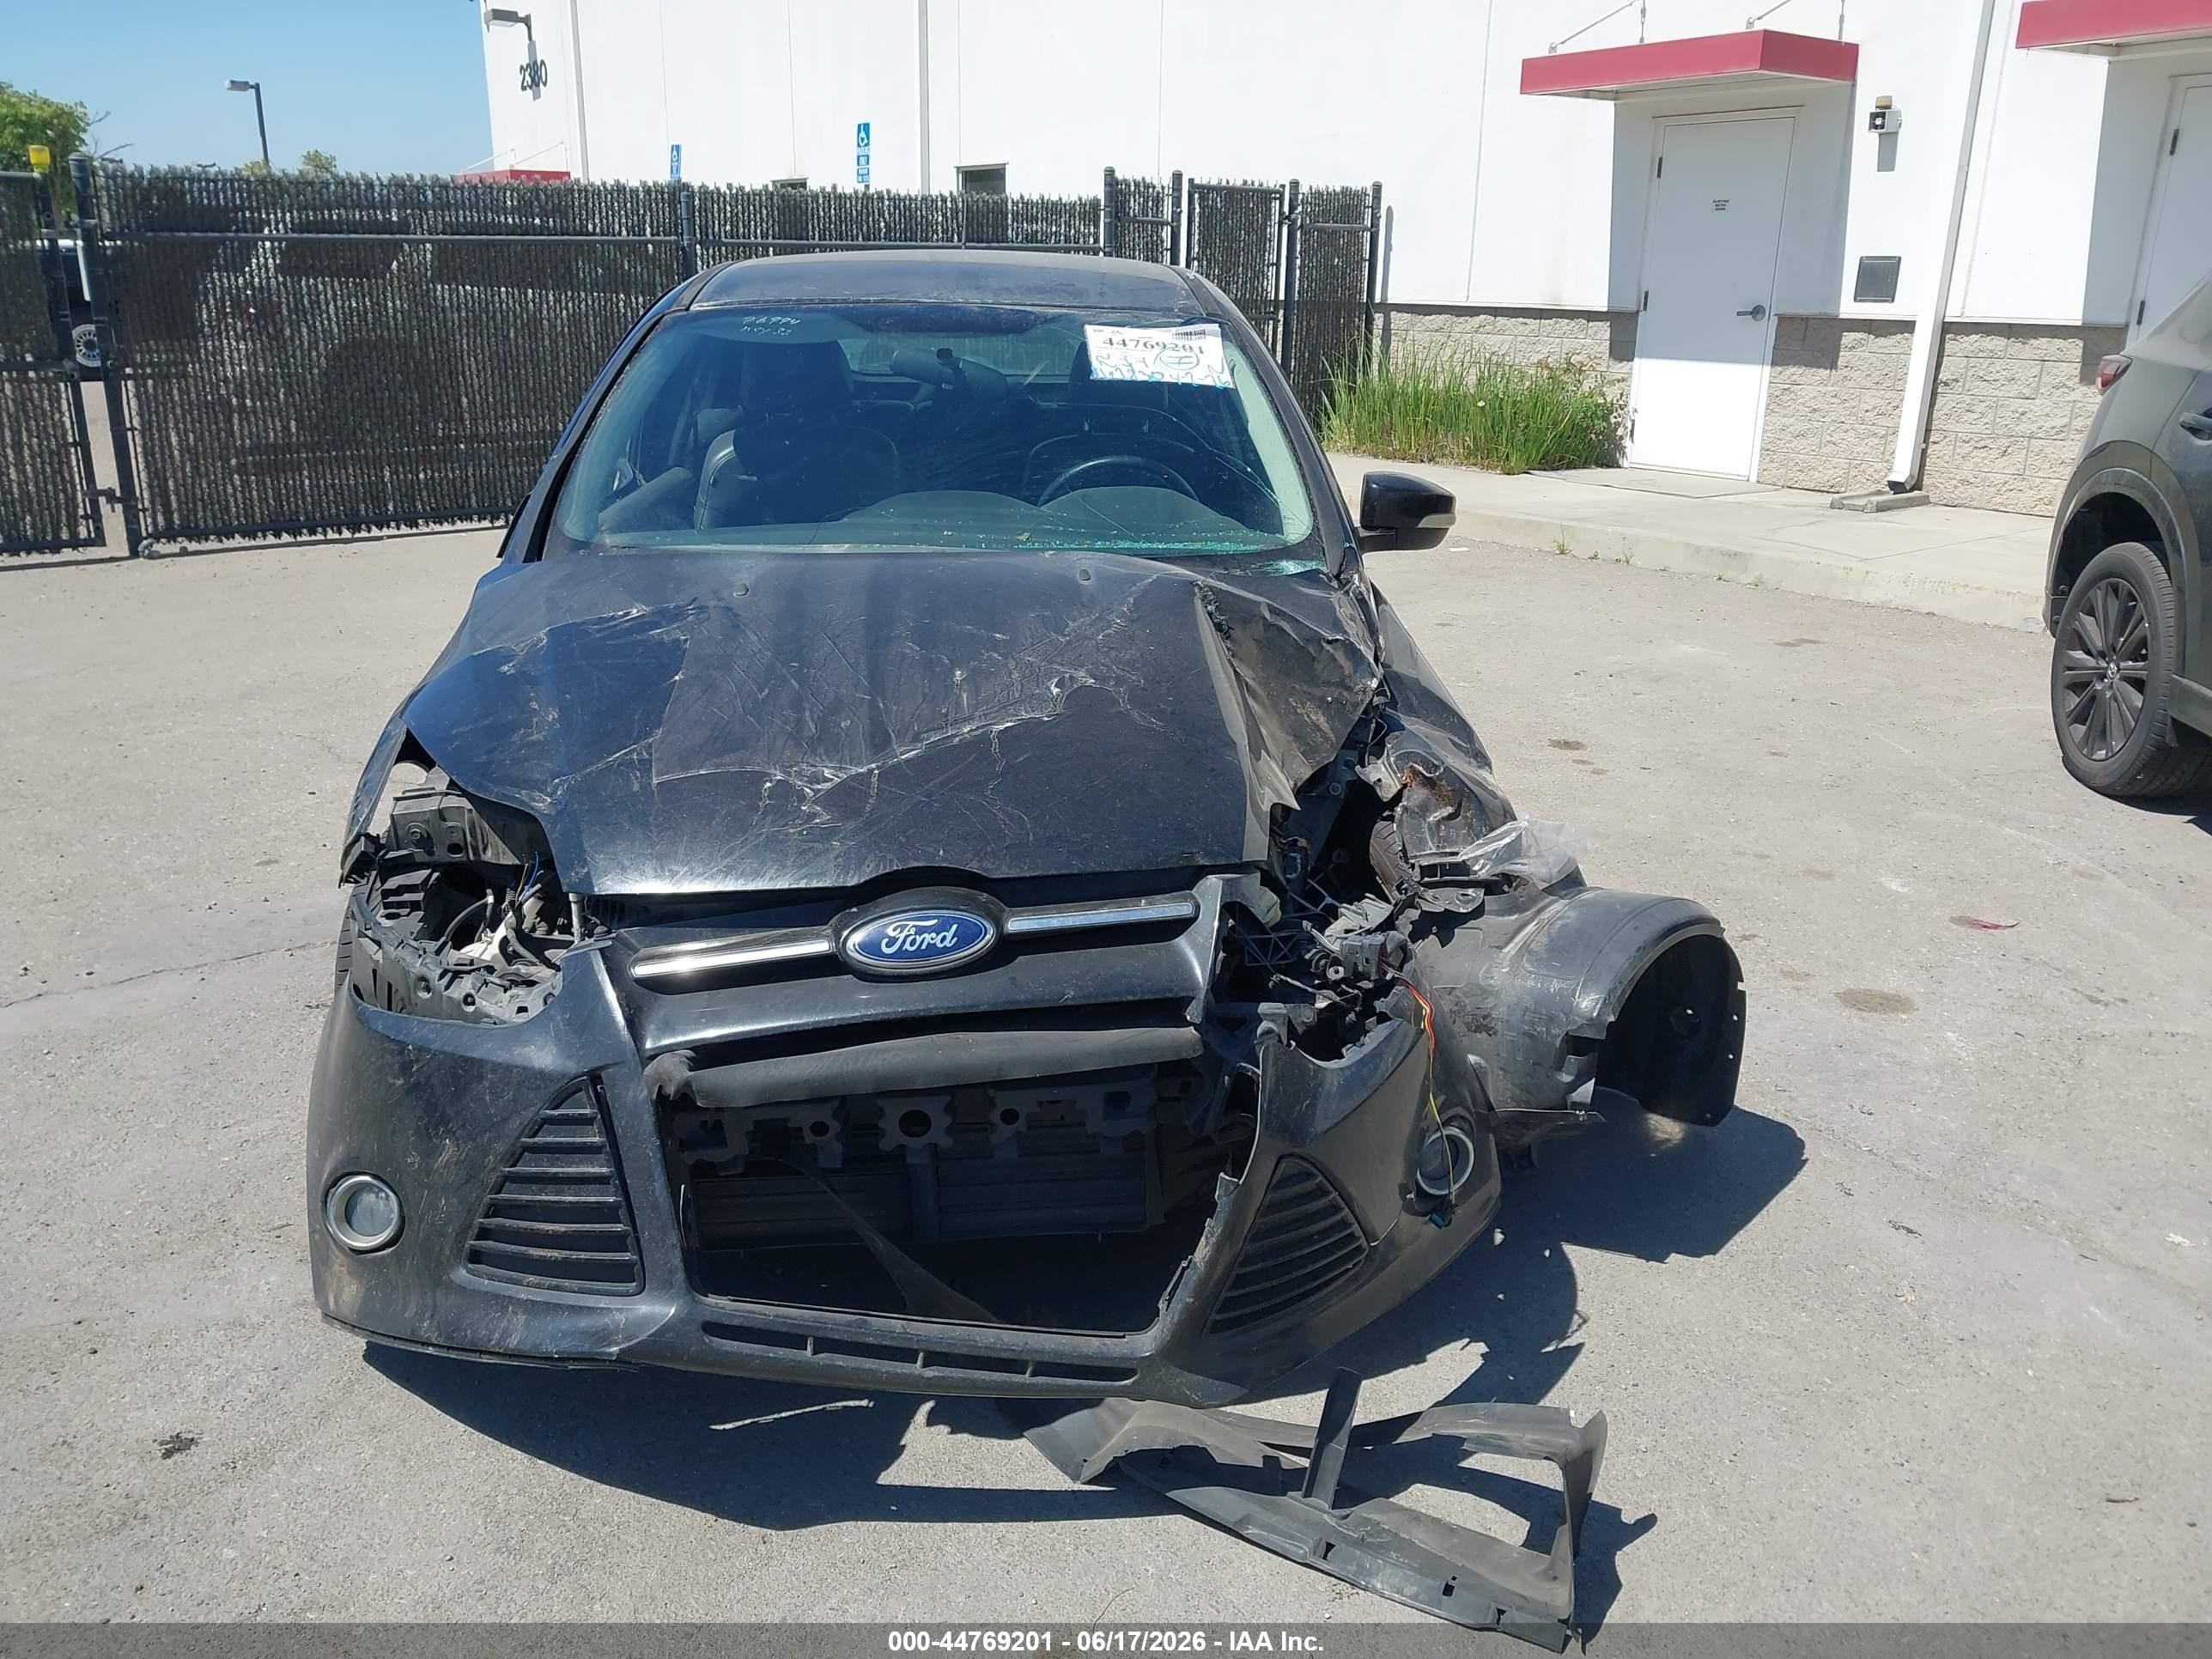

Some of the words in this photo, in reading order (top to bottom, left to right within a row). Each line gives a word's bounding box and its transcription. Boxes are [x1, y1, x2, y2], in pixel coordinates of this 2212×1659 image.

[520, 59, 548, 92] 2380
[1103, 337, 1205, 355] 44769201
[881, 919, 958, 954] Ford
